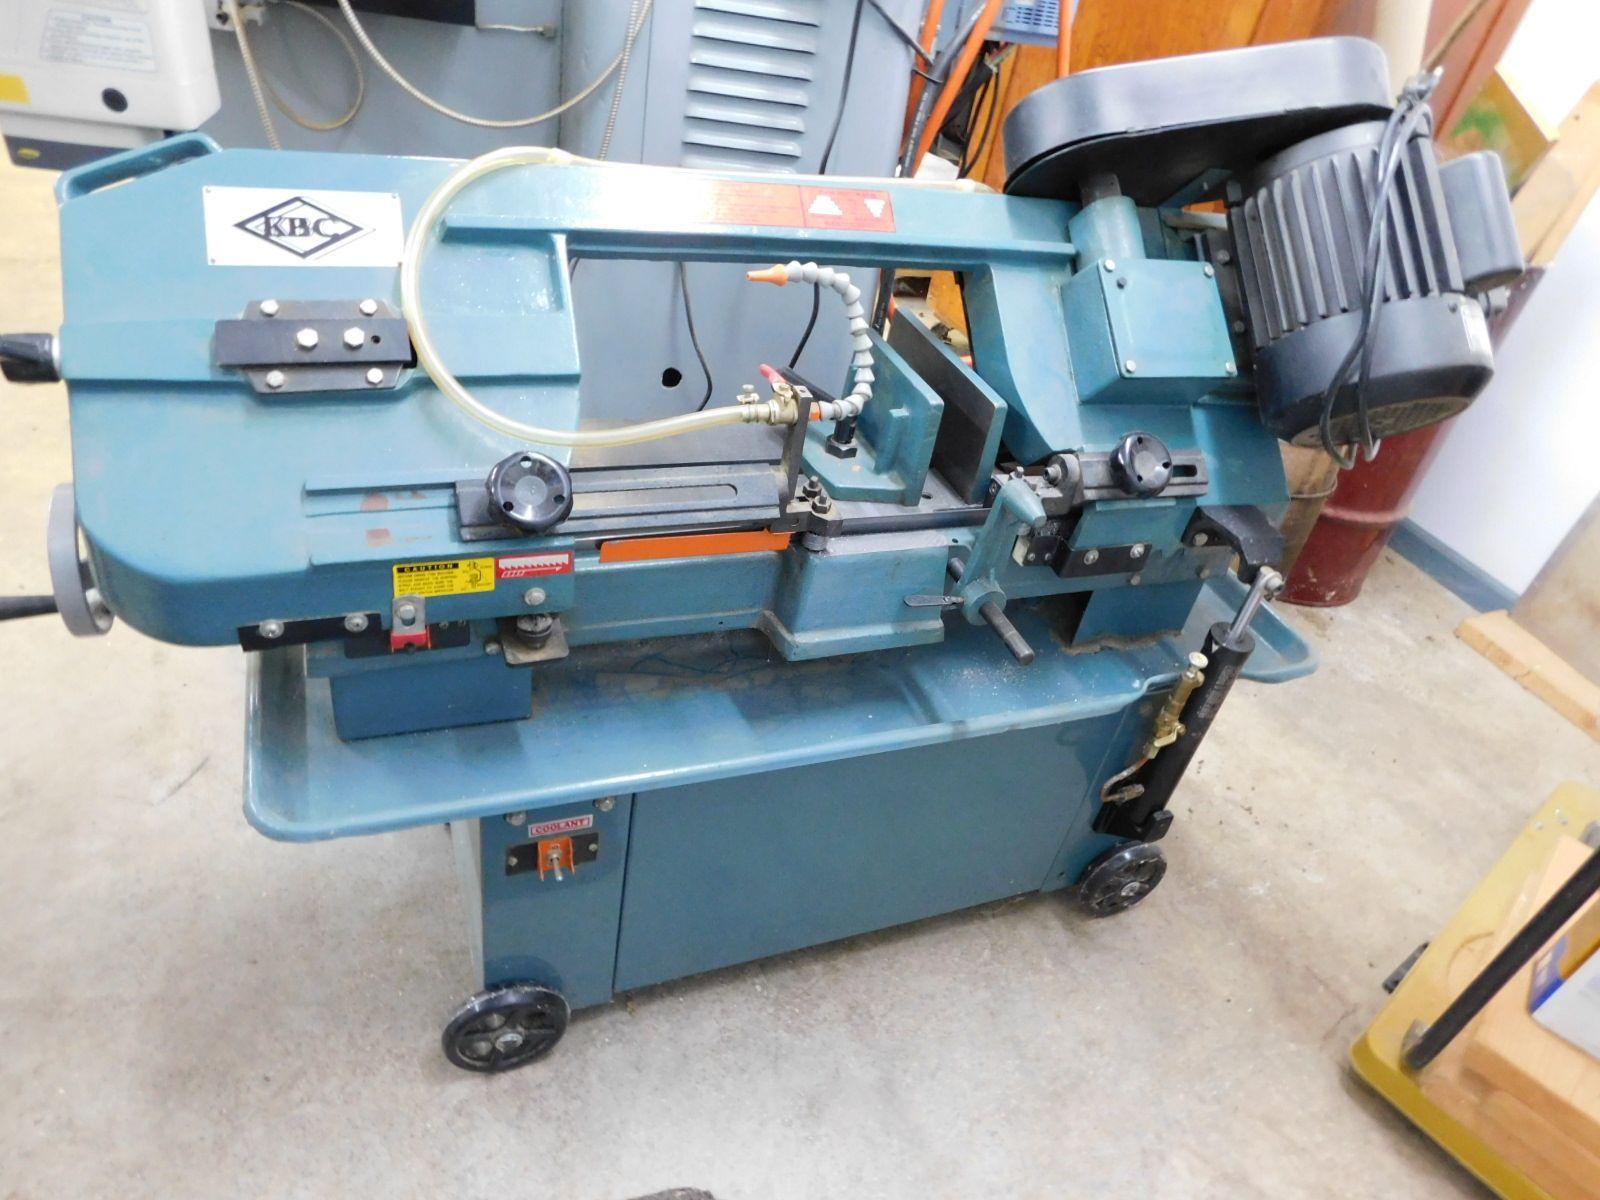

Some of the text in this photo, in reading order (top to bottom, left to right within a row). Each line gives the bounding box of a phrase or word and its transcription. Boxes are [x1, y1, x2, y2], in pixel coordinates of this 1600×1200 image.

[263, 216, 341, 238] KBC
[404, 563, 453, 573] CAUTION
[535, 819, 585, 834] COOLANT
